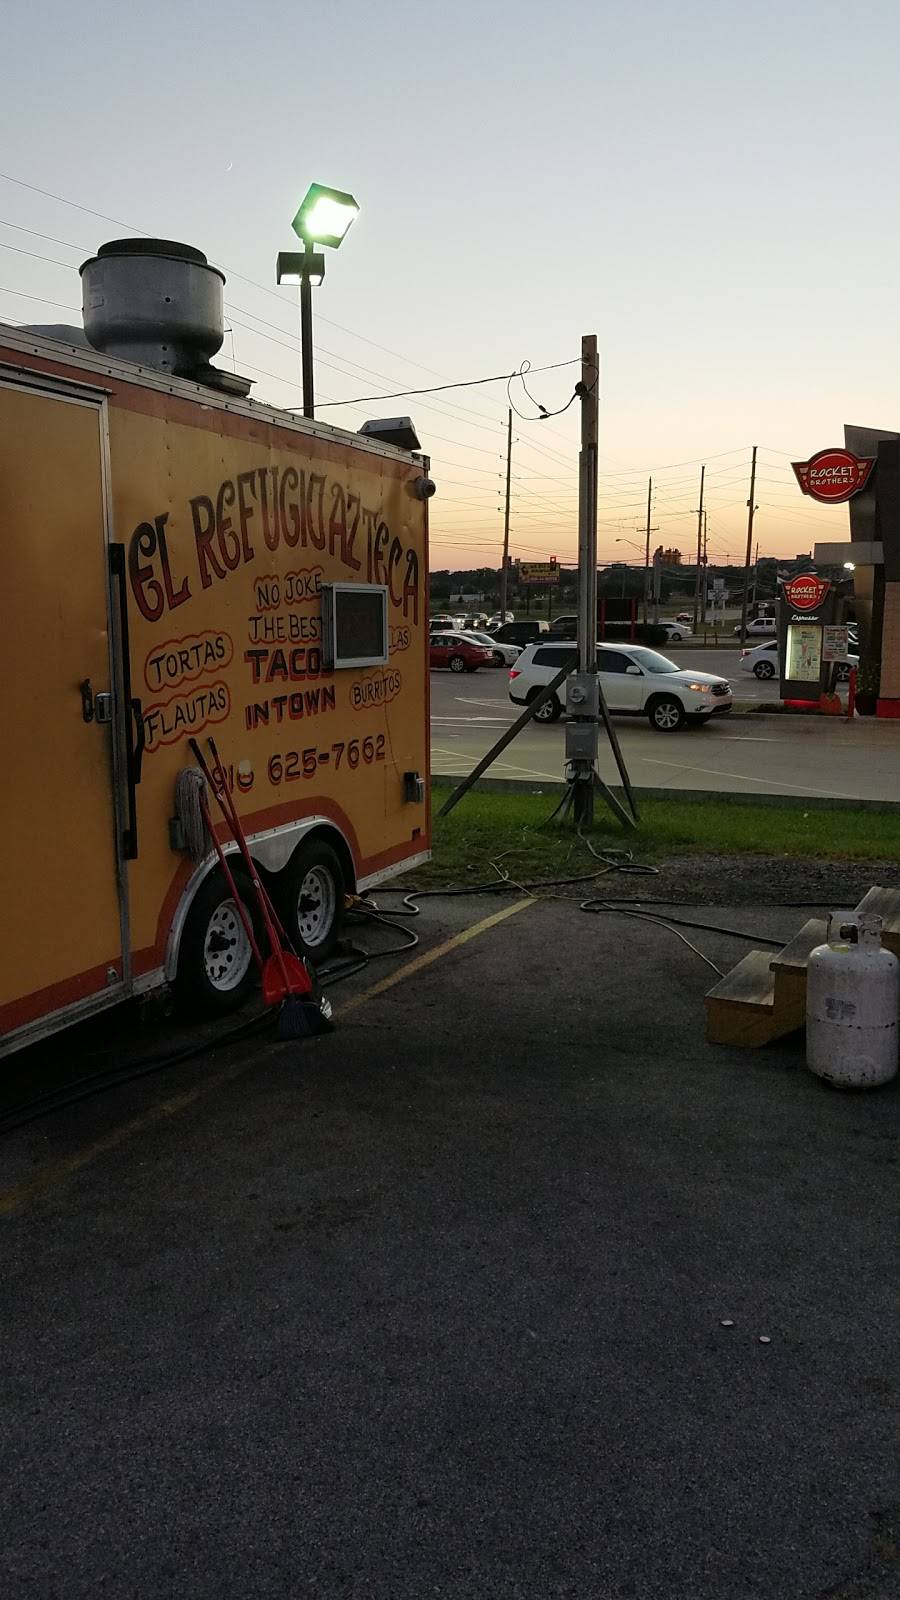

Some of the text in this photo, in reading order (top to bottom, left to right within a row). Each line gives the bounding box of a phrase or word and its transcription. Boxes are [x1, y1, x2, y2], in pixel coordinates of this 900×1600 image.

[810, 466, 854, 478] ROCKET
[810, 477, 854, 486] BROTHERS
[128, 466, 419, 626] EL REFUGIO AZTECA
[257, 572, 323, 610] NO JOKE
[791, 585, 817, 595] ROCKET
[248, 616, 285, 641] THE
[150, 636, 225, 684] TORTAS
[244, 647, 335, 685] TACO
[353, 672, 401, 704] BURRITOS
[143, 687, 226, 745] FLAUTAS
[268, 734, 386, 786] 625-7662
